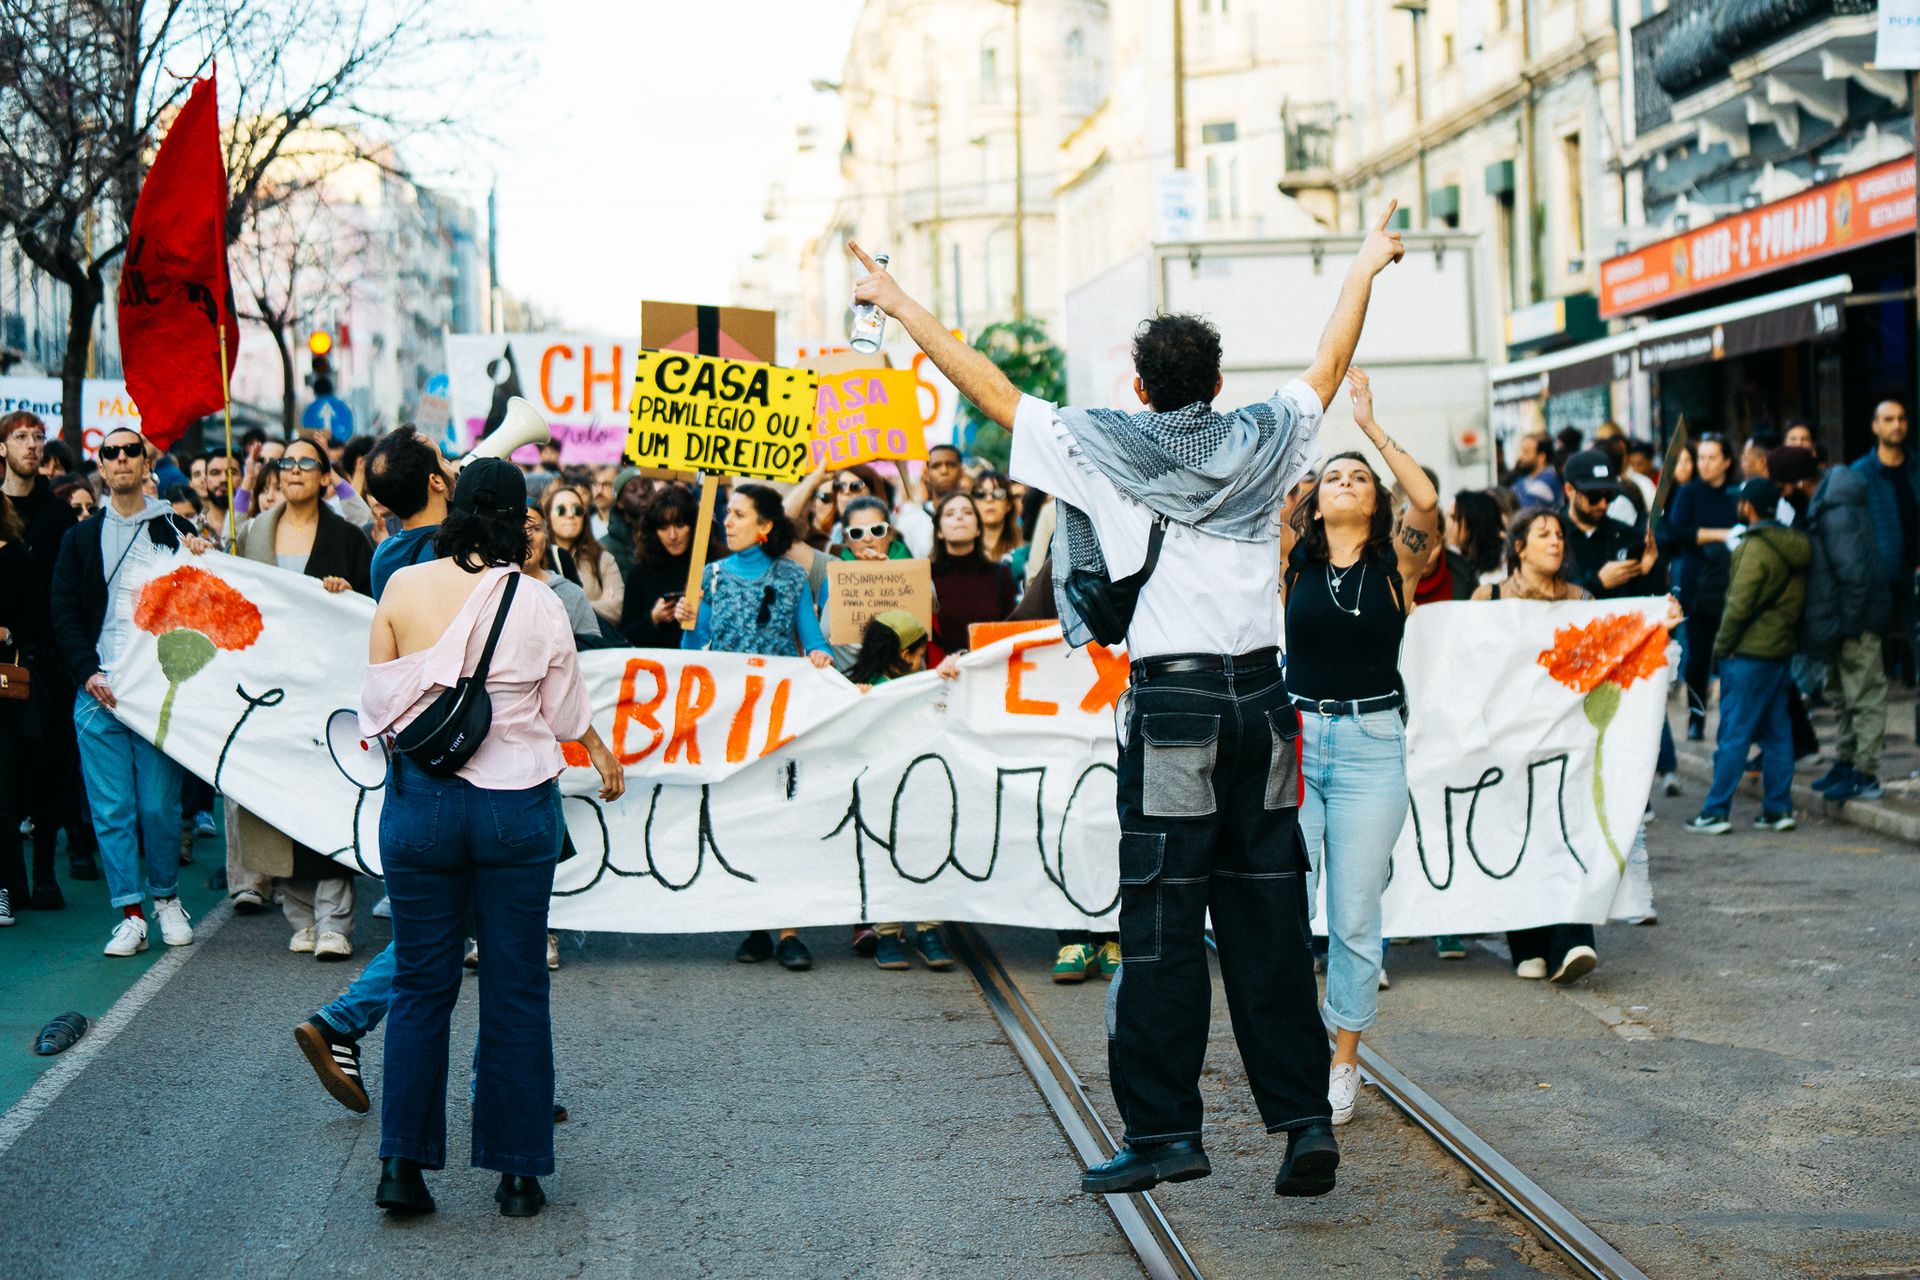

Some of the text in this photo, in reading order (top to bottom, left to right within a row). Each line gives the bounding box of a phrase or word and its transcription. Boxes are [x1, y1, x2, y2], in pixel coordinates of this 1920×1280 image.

[637, 395, 800, 438] PRIVILÉGIO OU
[816, 377, 890, 417] ASA
[637, 431, 808, 474] UM DIREITO?
[841, 588, 860, 598] QUE
[864, 589, 875, 597] AS
[560, 637, 1131, 768] BRIL EX
